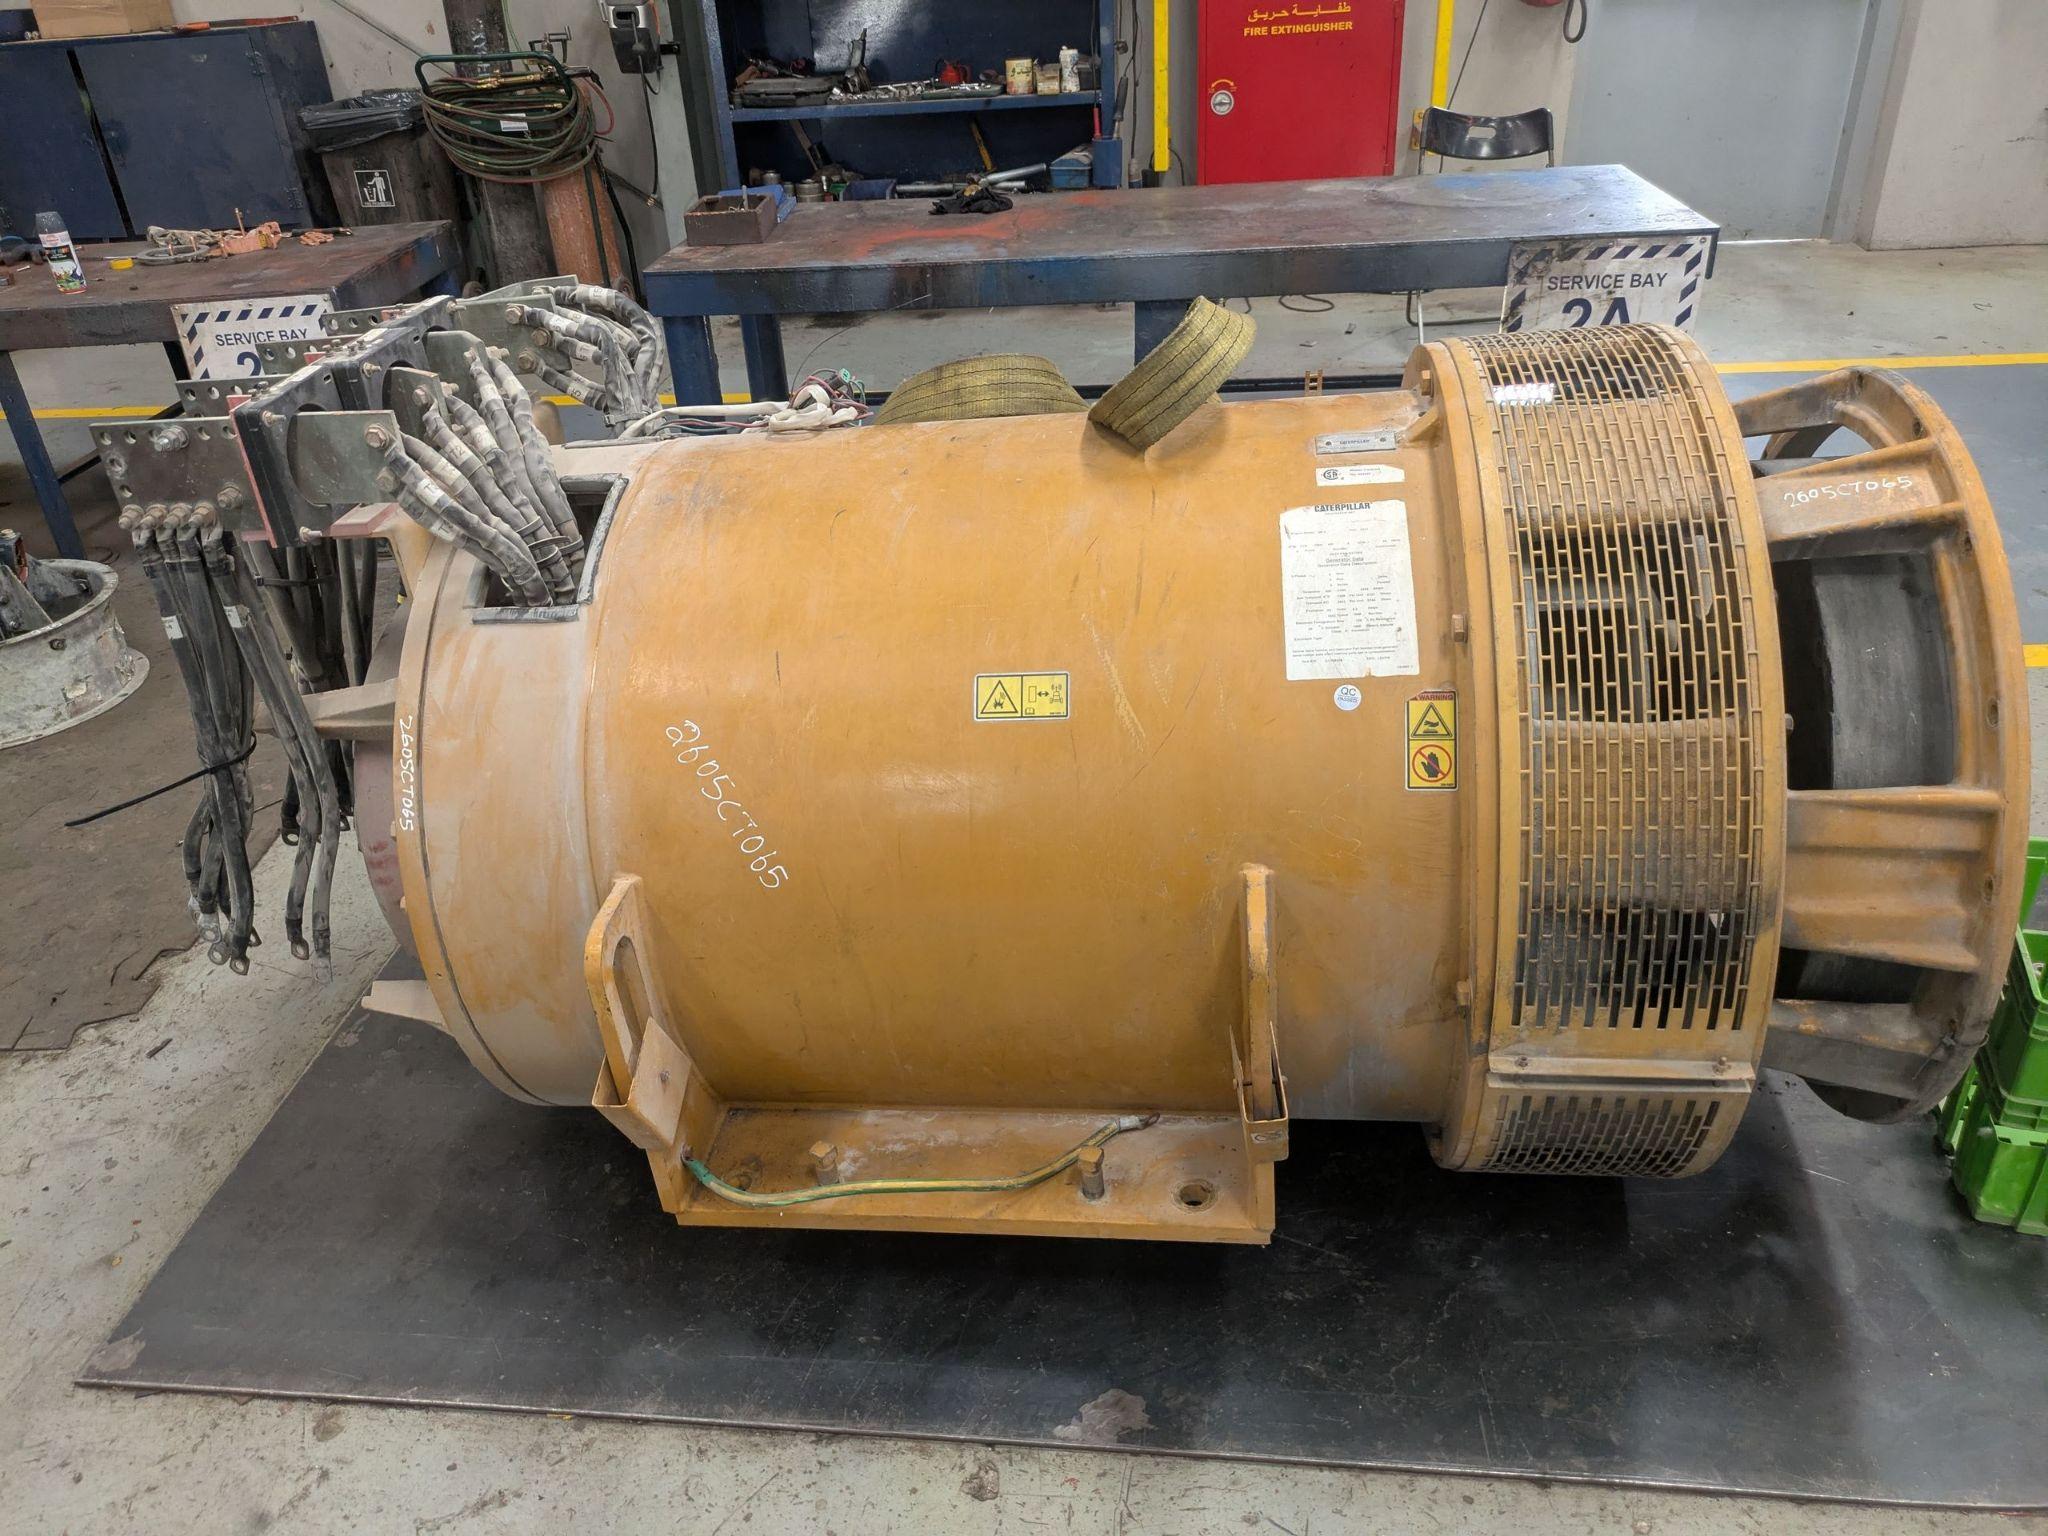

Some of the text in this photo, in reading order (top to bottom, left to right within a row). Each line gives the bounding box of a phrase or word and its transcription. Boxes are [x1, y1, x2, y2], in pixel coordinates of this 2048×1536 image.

[1247, 9, 1289, 23] حريق
[1243, 21, 1353, 36] FIRE EXTINGUISHER
[1547, 272, 1668, 291] SERVICE BAY
[215, 328, 308, 347] SERVICE BAY
[236, 351, 262, 376] 2
[1314, 502, 1371, 512] CATERPILLAR
[1340, 686, 1357, 697] QC
[1418, 693, 1454, 701] WARNING
[665, 719, 789, 888] 2605CT065
